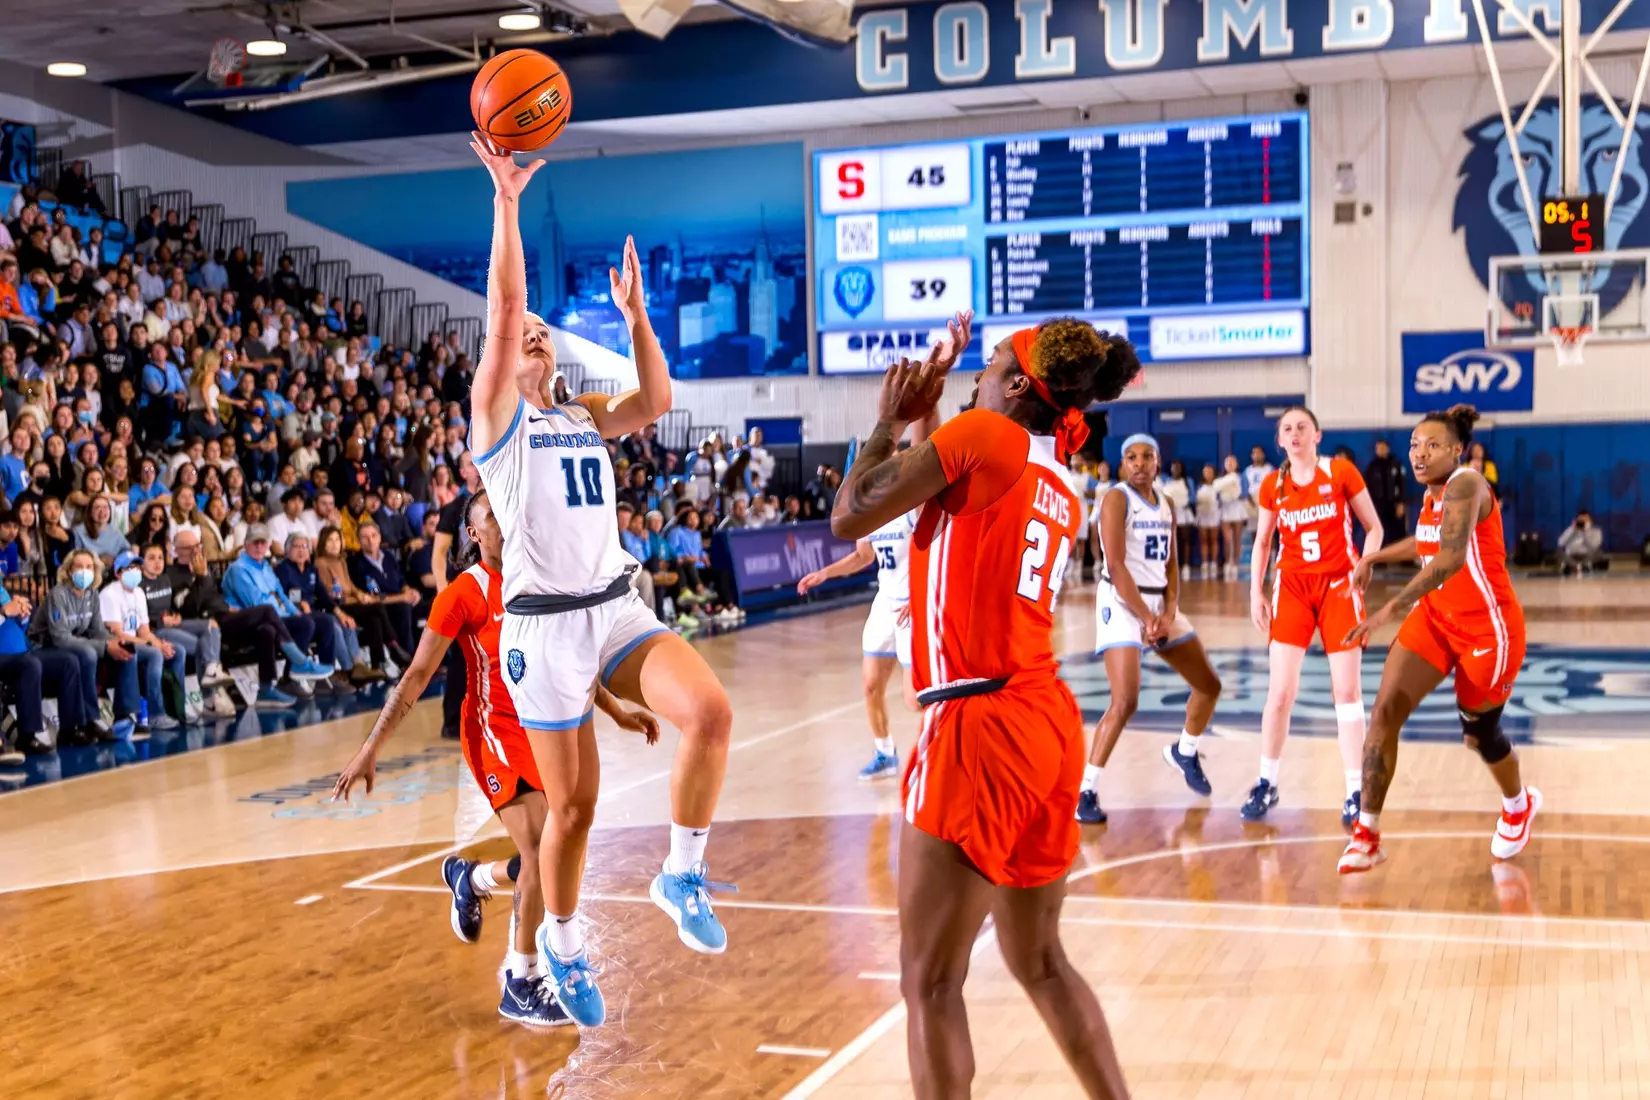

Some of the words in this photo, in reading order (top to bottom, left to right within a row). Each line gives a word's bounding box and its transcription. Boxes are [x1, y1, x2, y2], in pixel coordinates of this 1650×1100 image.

[514, 89, 562, 128] ELITE
[907, 165, 946, 188] 45
[911, 278, 947, 300] 39
[1414, 362, 1503, 394] SNY
[560, 456, 605, 508] 10
[1032, 478, 1070, 528] LEWIS
[1278, 502, 1338, 533] Syracuse
[1299, 531, 1321, 562] 5
